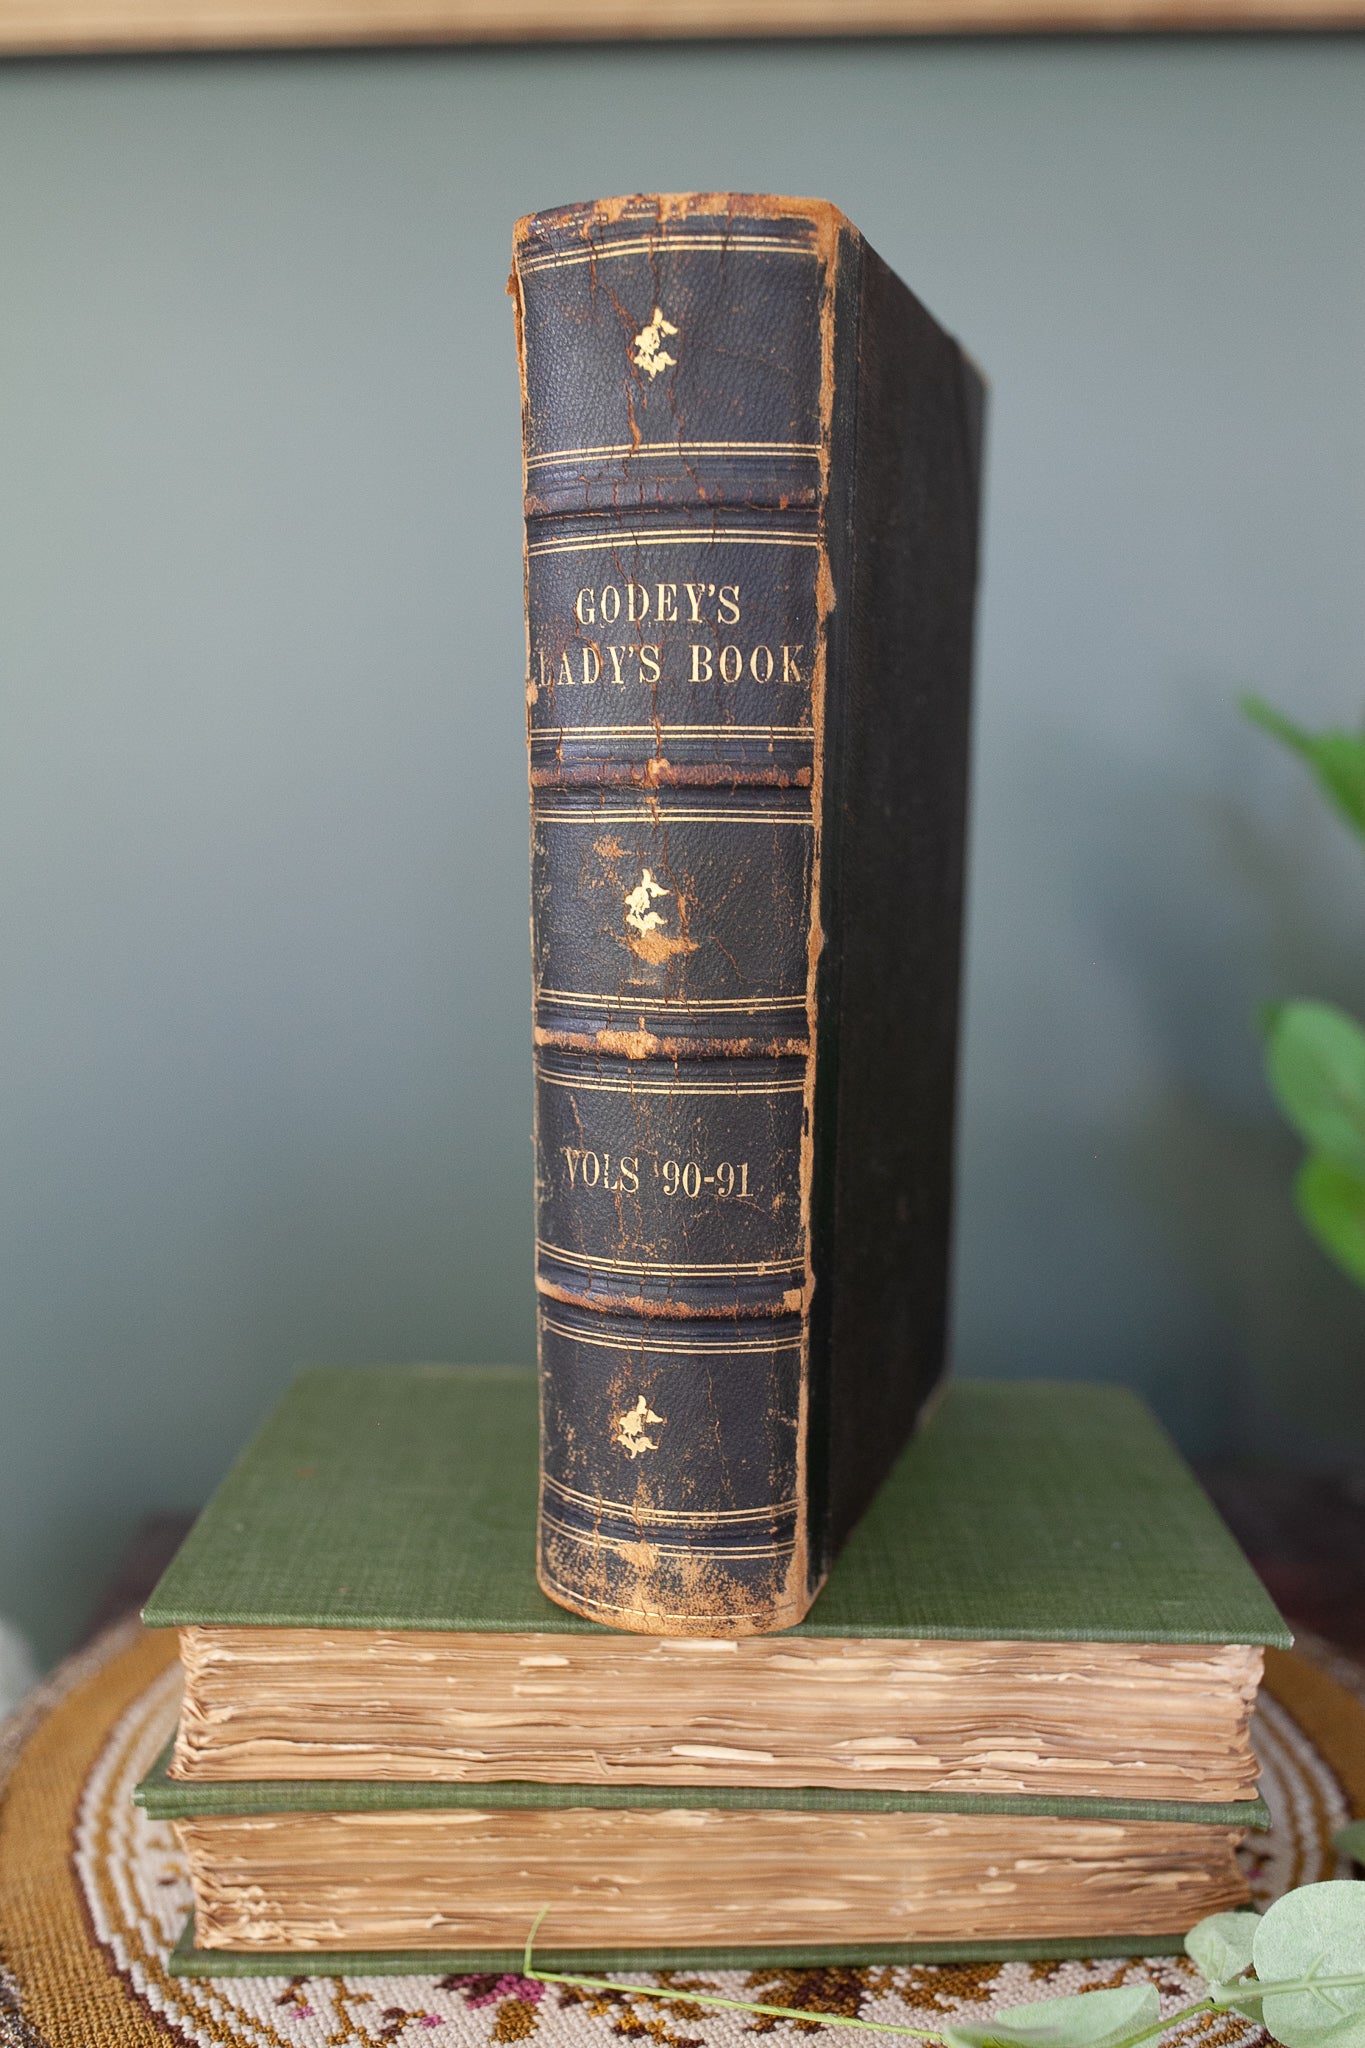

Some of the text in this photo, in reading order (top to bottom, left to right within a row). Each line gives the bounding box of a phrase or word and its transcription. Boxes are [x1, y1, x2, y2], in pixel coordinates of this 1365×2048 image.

[575, 583, 740, 625] GODEY'S
[538, 644, 804, 687] LADY'S BOOK
[563, 1147, 639, 1193] VOLS
